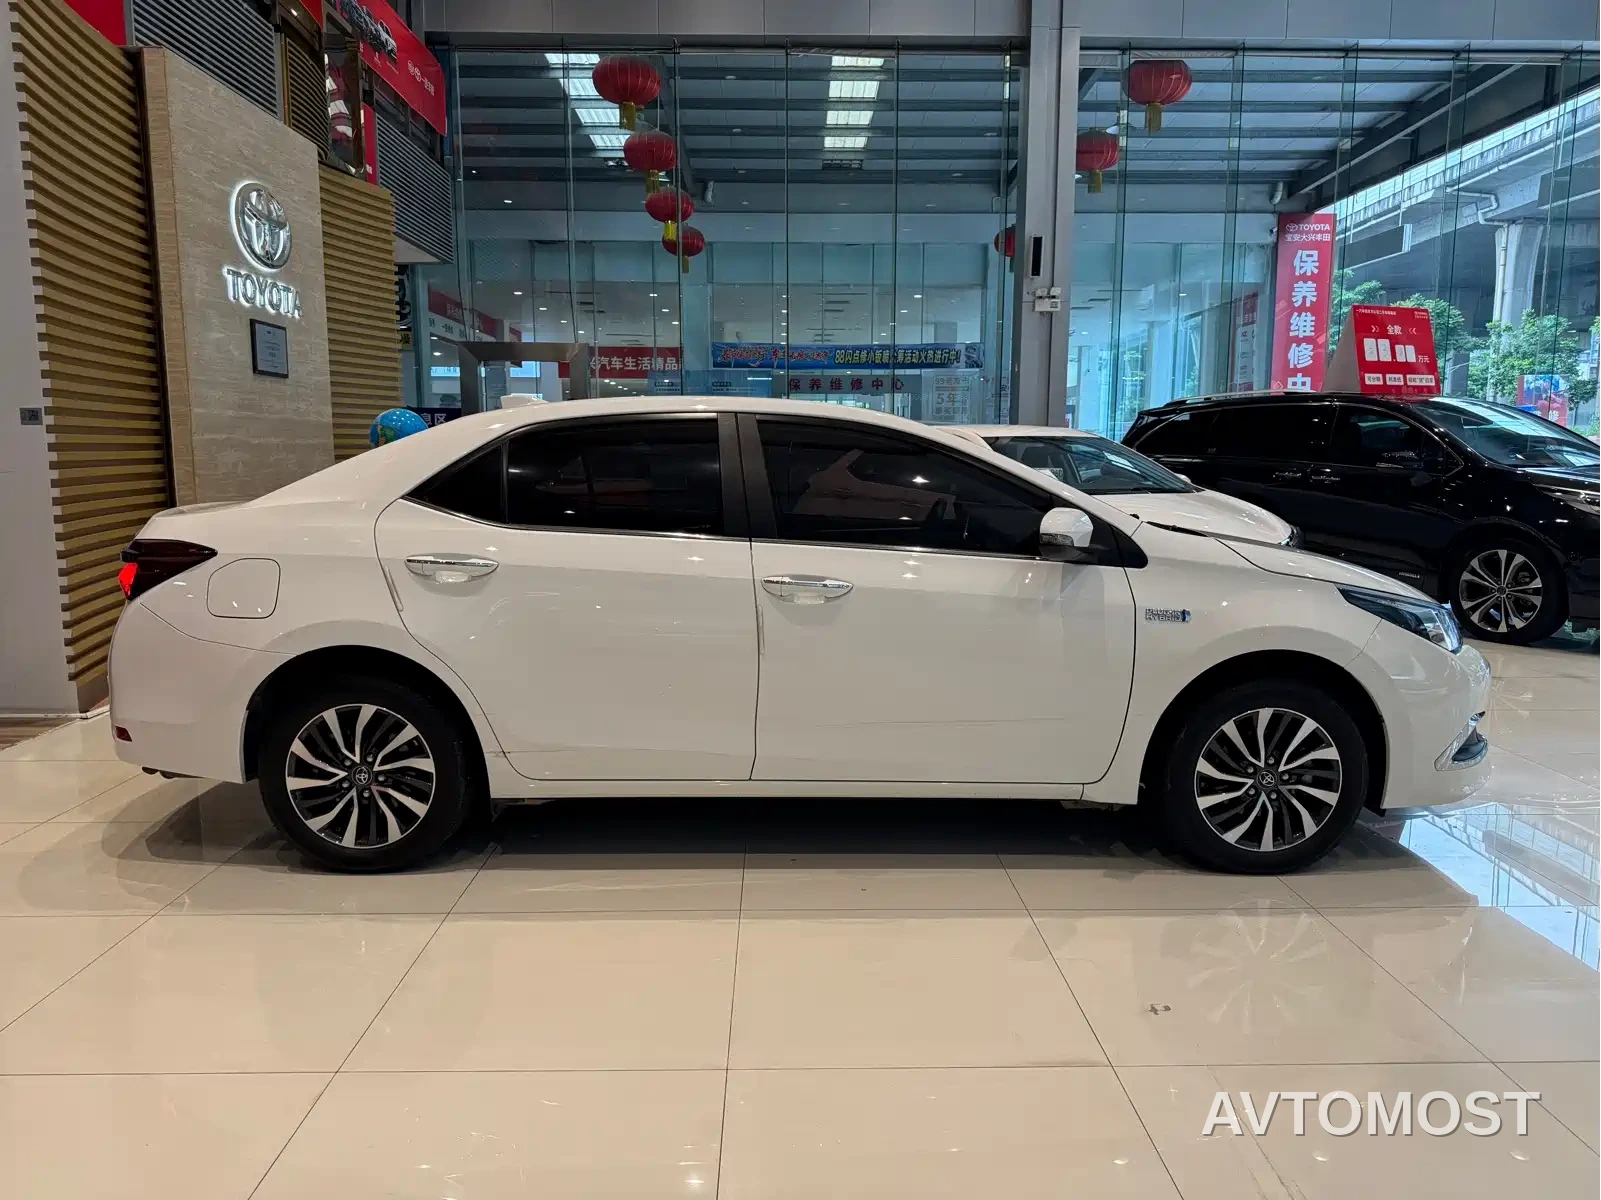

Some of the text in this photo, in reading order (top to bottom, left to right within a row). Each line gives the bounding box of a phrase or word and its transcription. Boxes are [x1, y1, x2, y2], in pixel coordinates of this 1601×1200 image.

[1299, 223, 1330, 231] TOYOTA
[1285, 233, 1331, 242] 宝安大兴丰田
[223, 265, 303, 318] TOYOTA
[1386, 324, 1402, 335] 全款
[789, 378, 904, 391] 保养维修中心
